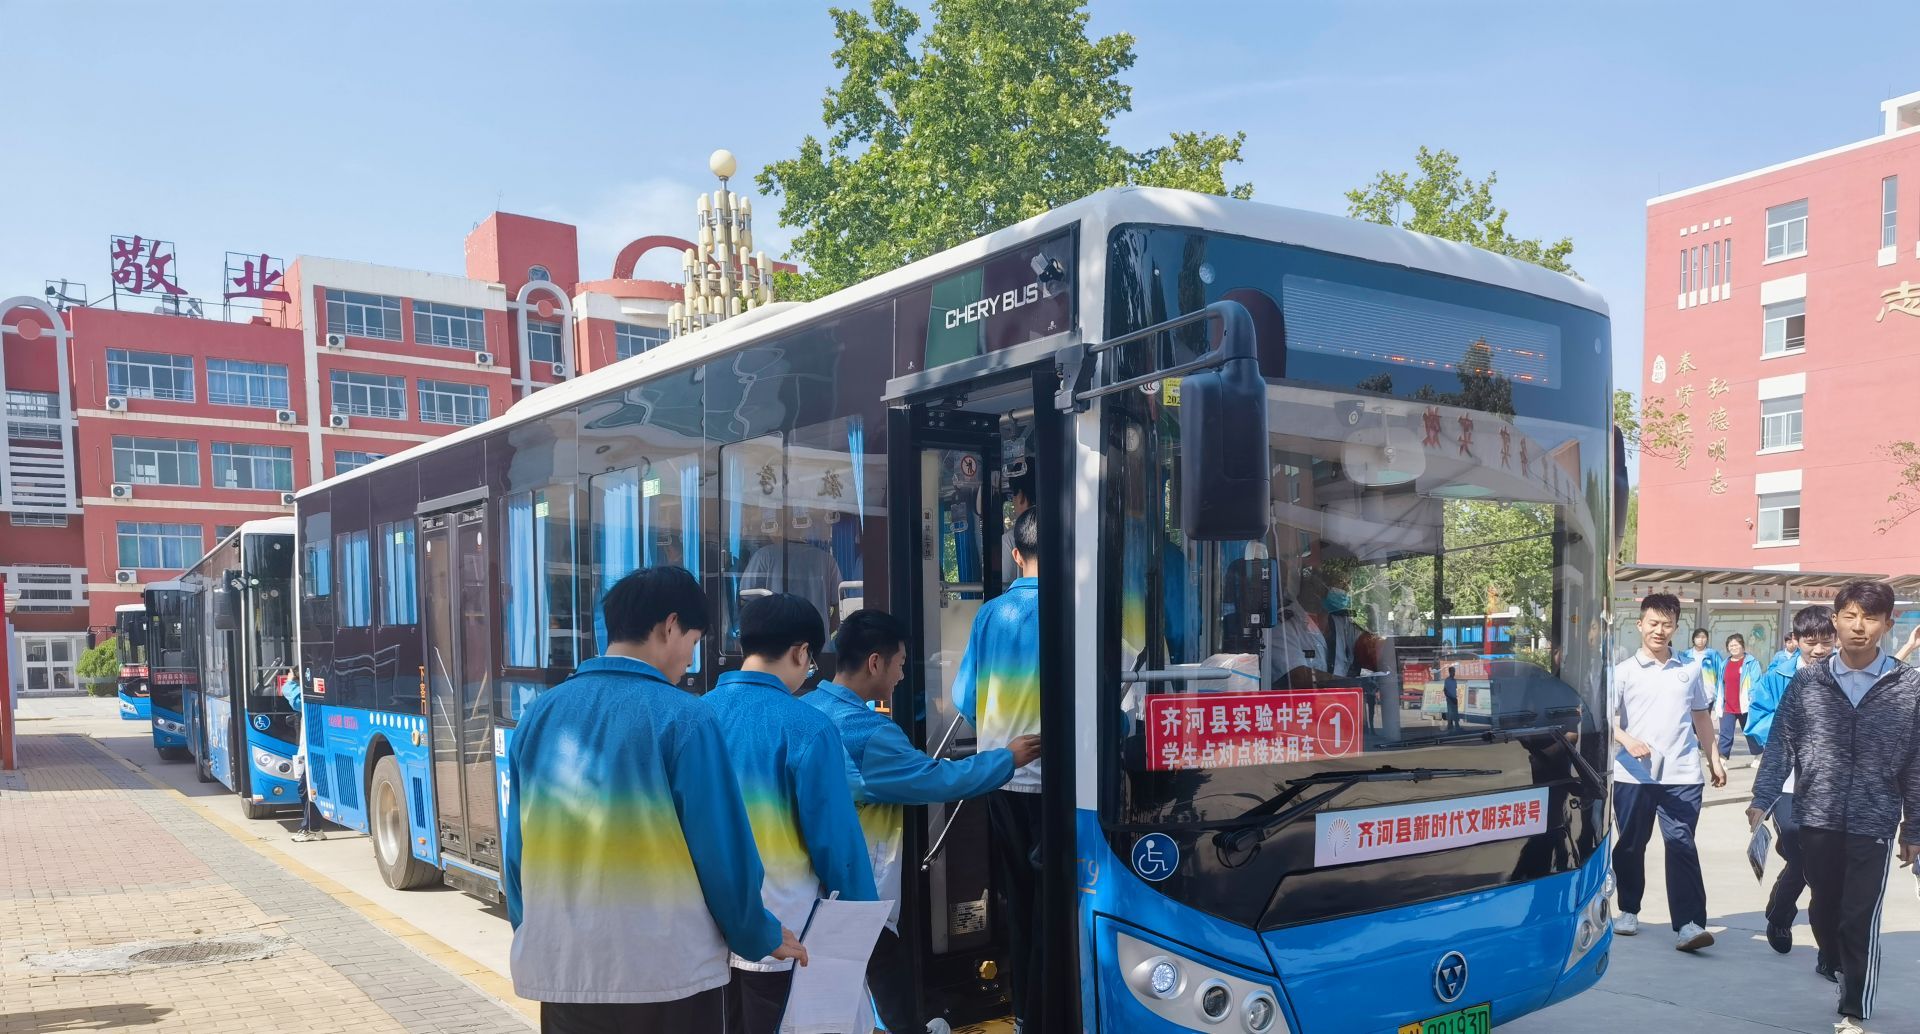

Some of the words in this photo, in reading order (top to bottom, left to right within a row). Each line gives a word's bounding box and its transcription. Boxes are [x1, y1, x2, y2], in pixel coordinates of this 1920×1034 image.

[111, 235, 292, 304] 敬业
[945, 294, 1001, 330] CHERY
[1002, 282, 1038, 312] BUS
[1160, 702, 1313, 737] 齐河县实验中学
[1161, 735, 1315, 771] 学生点对点接送用车
[1357, 799, 1541, 849] 齐河县新时代文明实践号
